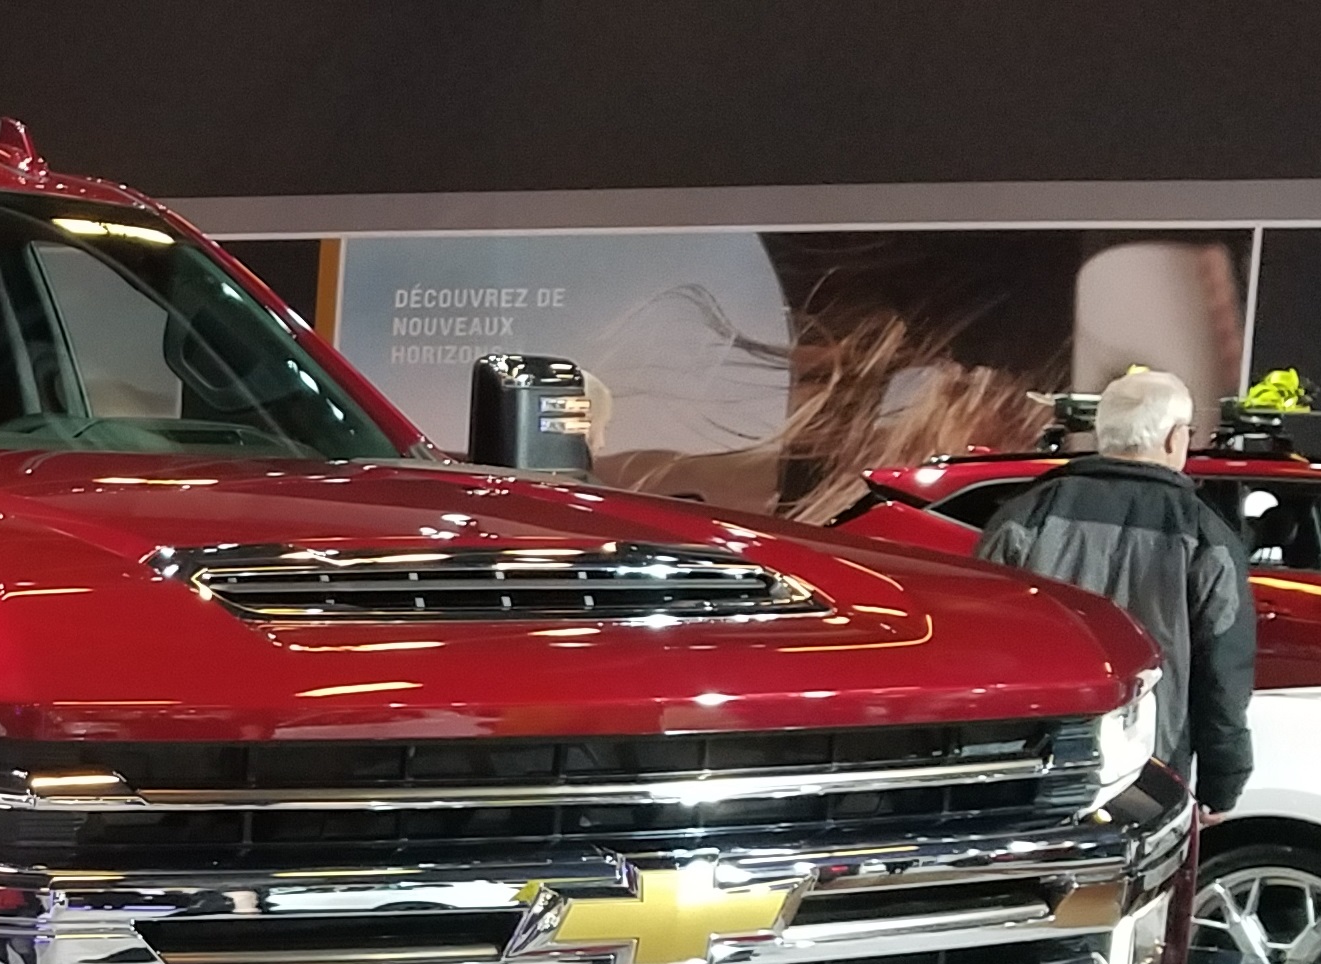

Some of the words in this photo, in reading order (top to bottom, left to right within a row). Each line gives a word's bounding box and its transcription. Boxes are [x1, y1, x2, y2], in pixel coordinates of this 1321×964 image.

[394, 283, 529, 308] DÉCOUVREZ
[536, 287, 567, 308] DE
[391, 316, 515, 337] NOUVEAUX
